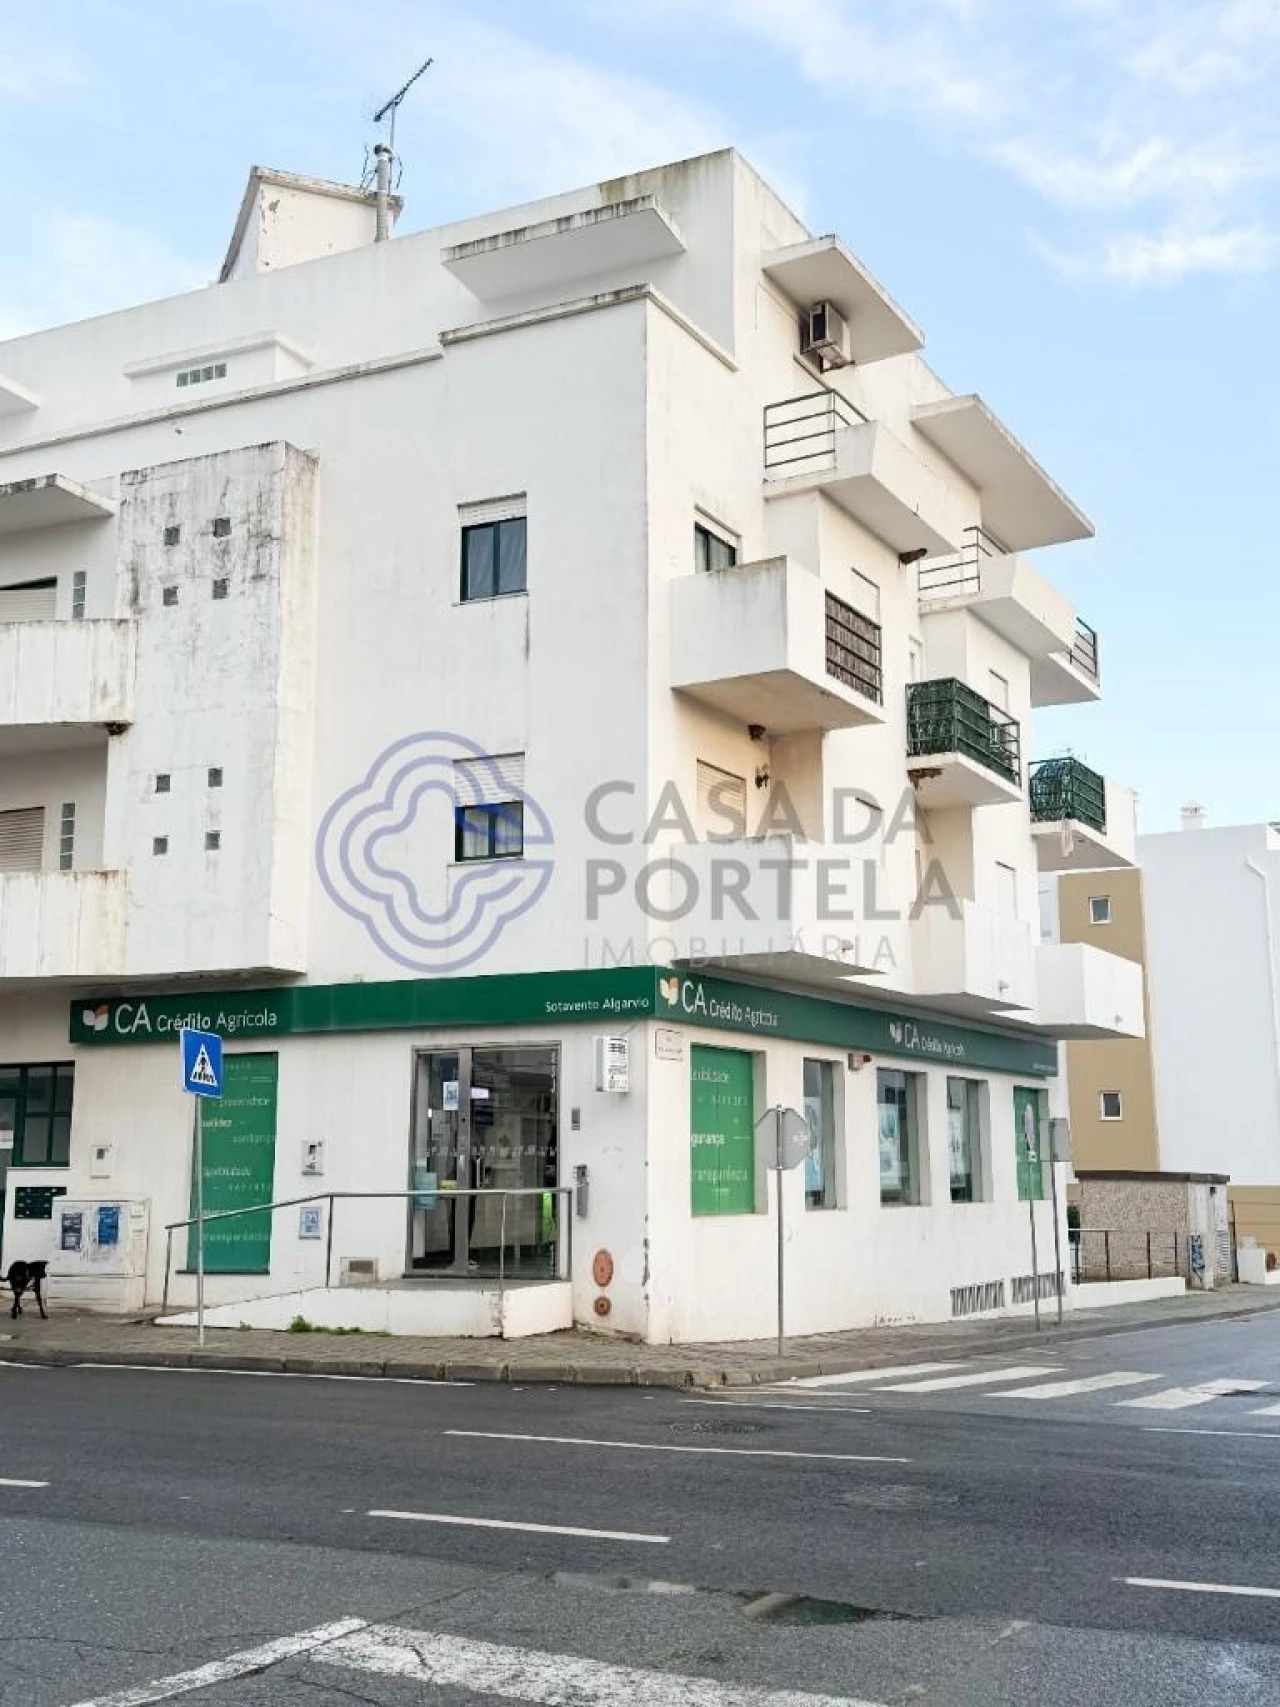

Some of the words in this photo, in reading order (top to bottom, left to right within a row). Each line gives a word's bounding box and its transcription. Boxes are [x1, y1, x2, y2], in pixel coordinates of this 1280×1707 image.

[546, 998, 599, 1014] Sotavento
[603, 997, 649, 1012] Algarvio
[682, 980, 708, 1017] CA
[710, 999, 742, 1022] Crédito
[114, 1003, 151, 1034] CA
[156, 1012, 211, 1032] Crédito
[215, 1008, 278, 1032] Agrícola
[904, 1023, 920, 1050] CA
